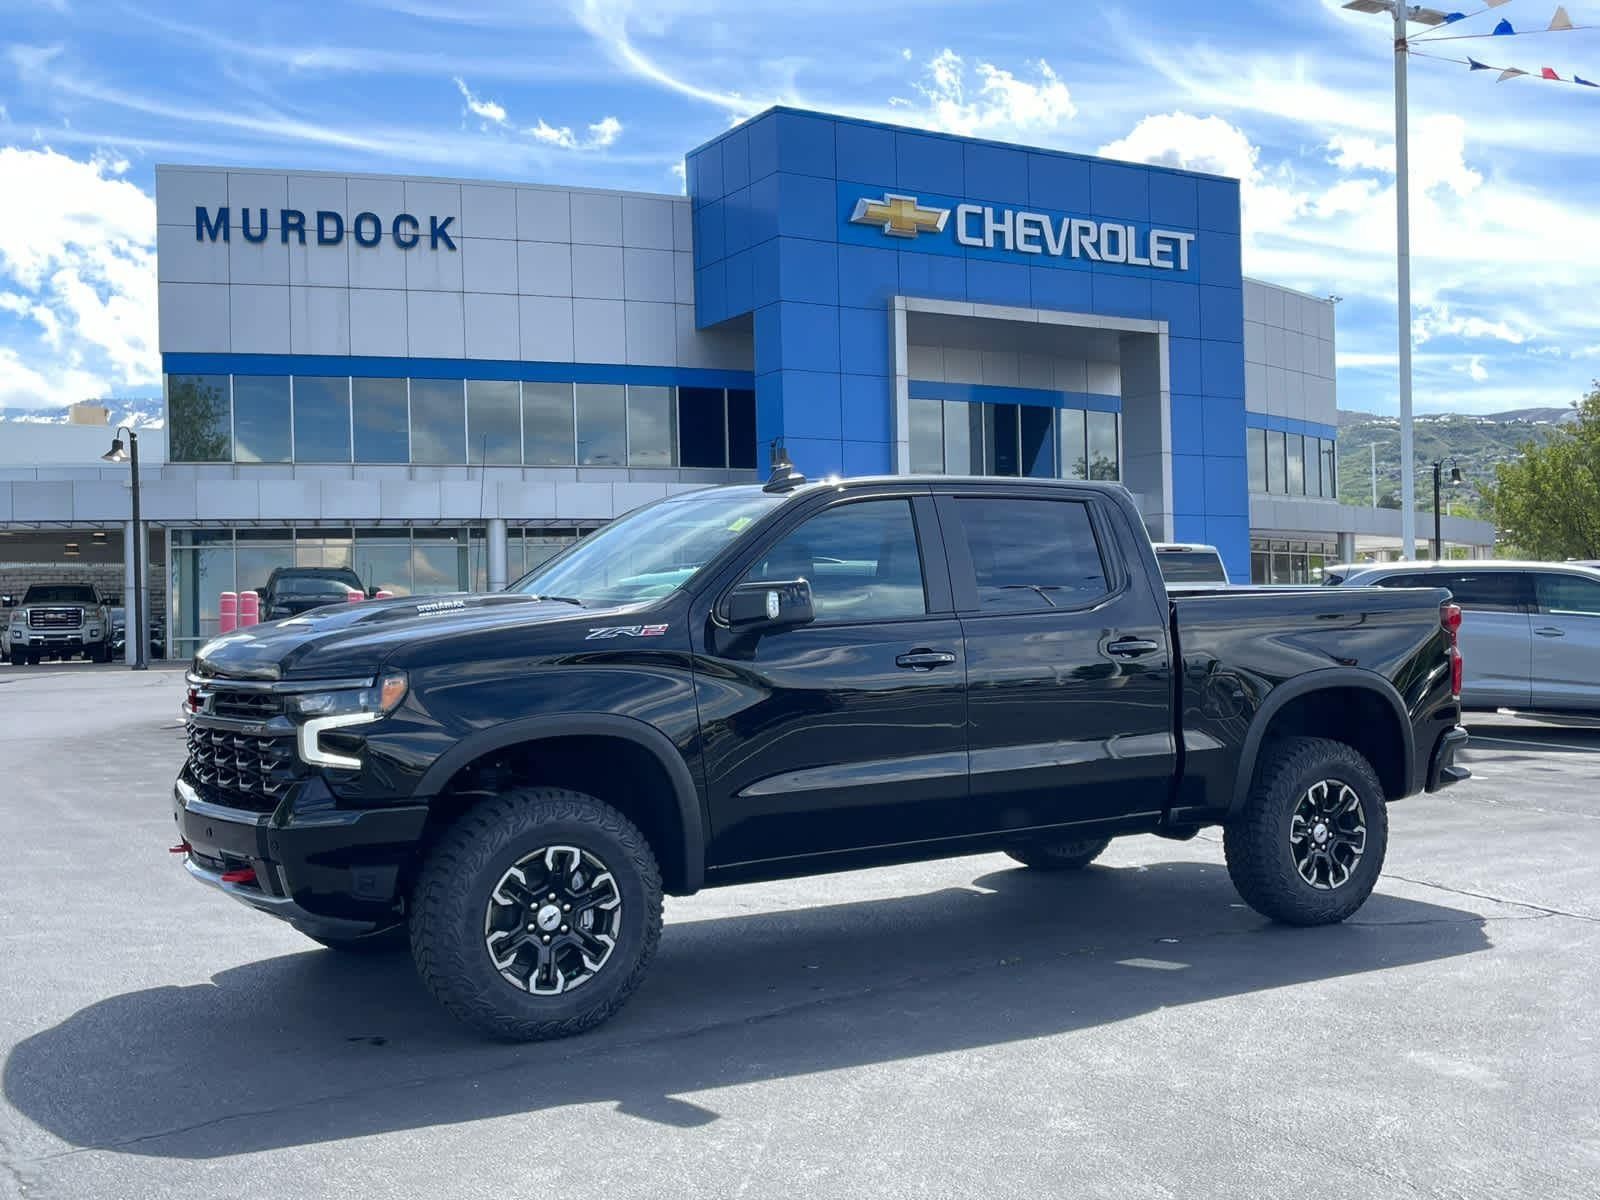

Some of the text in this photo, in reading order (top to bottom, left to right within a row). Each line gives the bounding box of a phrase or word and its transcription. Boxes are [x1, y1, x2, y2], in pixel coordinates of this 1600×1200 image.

[195, 206, 457, 251] MURDOCK
[956, 203, 1195, 270] CHEVROLET
[585, 624, 669, 640] ZR2
